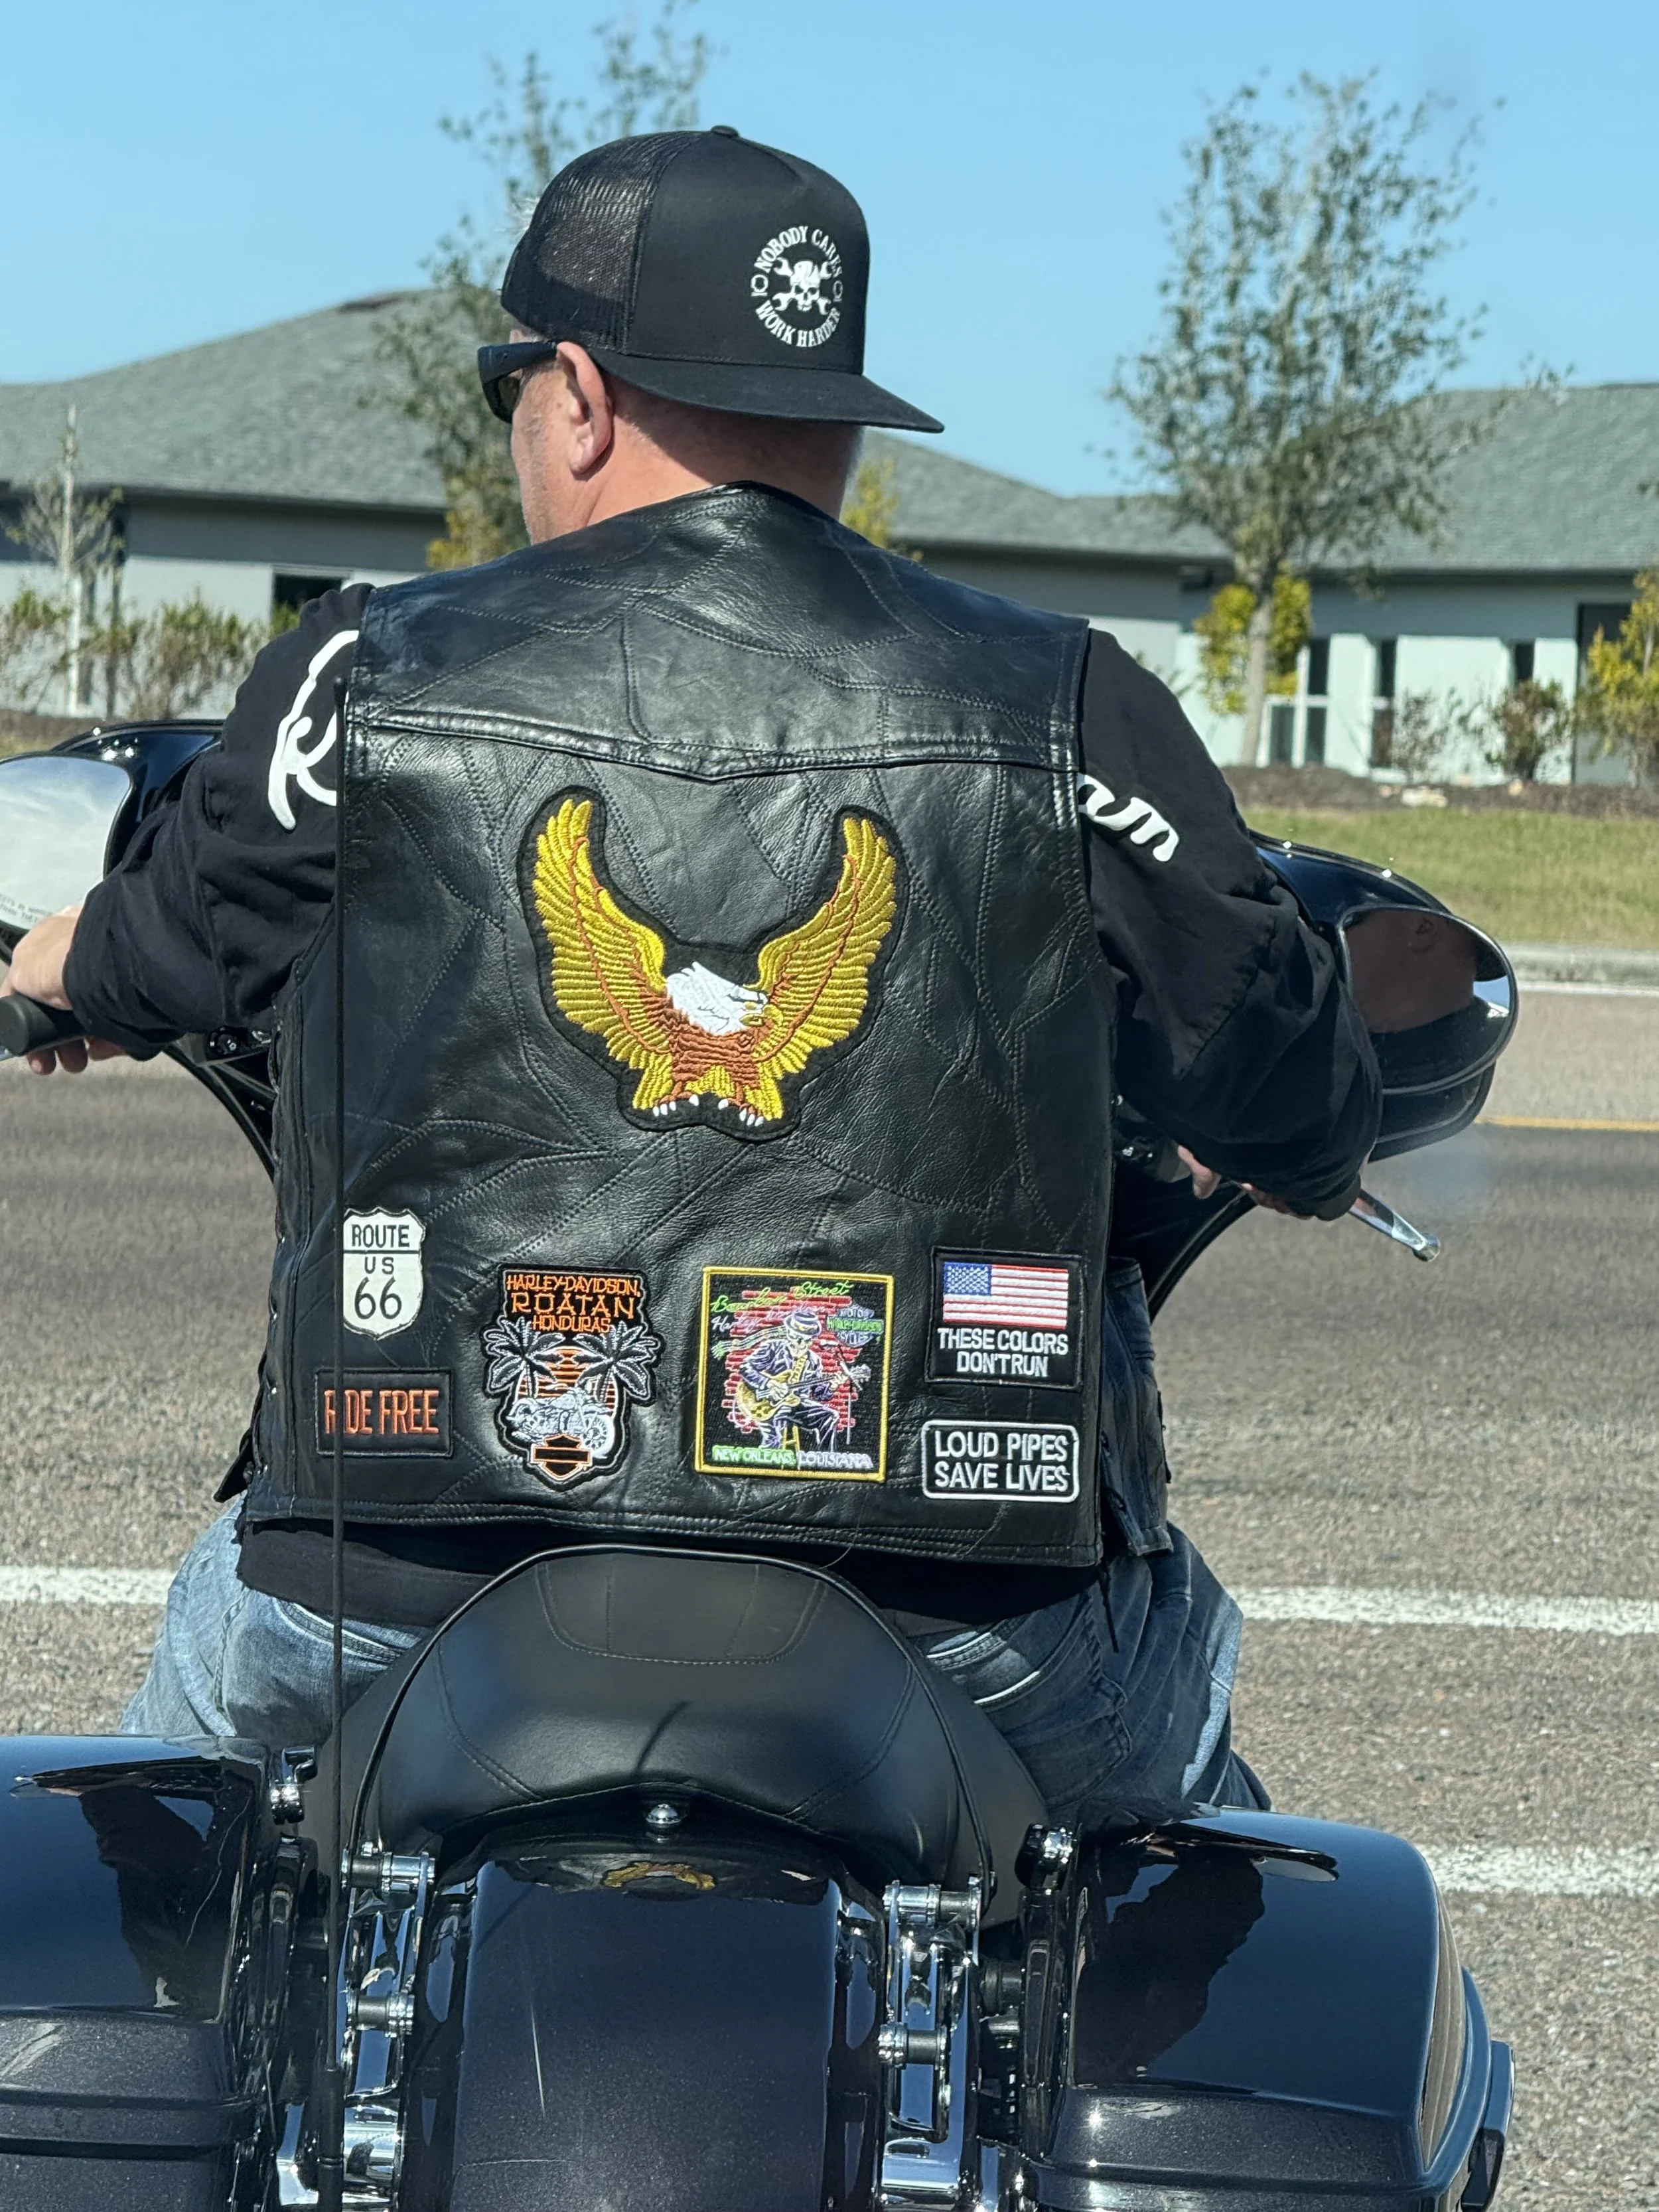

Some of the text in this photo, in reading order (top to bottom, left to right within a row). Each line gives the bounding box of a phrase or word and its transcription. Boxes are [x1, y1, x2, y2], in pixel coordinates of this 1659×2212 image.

[753, 226, 808, 273] NOBODY
[755, 300, 841, 348] WORK HARDER
[351, 1224, 410, 1248] ROUTE
[364, 1256, 395, 1275] US
[354, 1276, 402, 1320] 66
[511, 1292, 634, 1319] ROATAN
[532, 1314, 614, 1333] HONDURAS
[938, 1328, 1069, 1355] THESE COLORS
[957, 1351, 1048, 1377] DON'T RUN
[324, 1389, 439, 1434] RDE FREE
[934, 1430, 1068, 1462] LOUD PIPES
[798, 1451, 874, 1469] LOUISIANA
[934, 1461, 1070, 1492] SAVE LIVES
